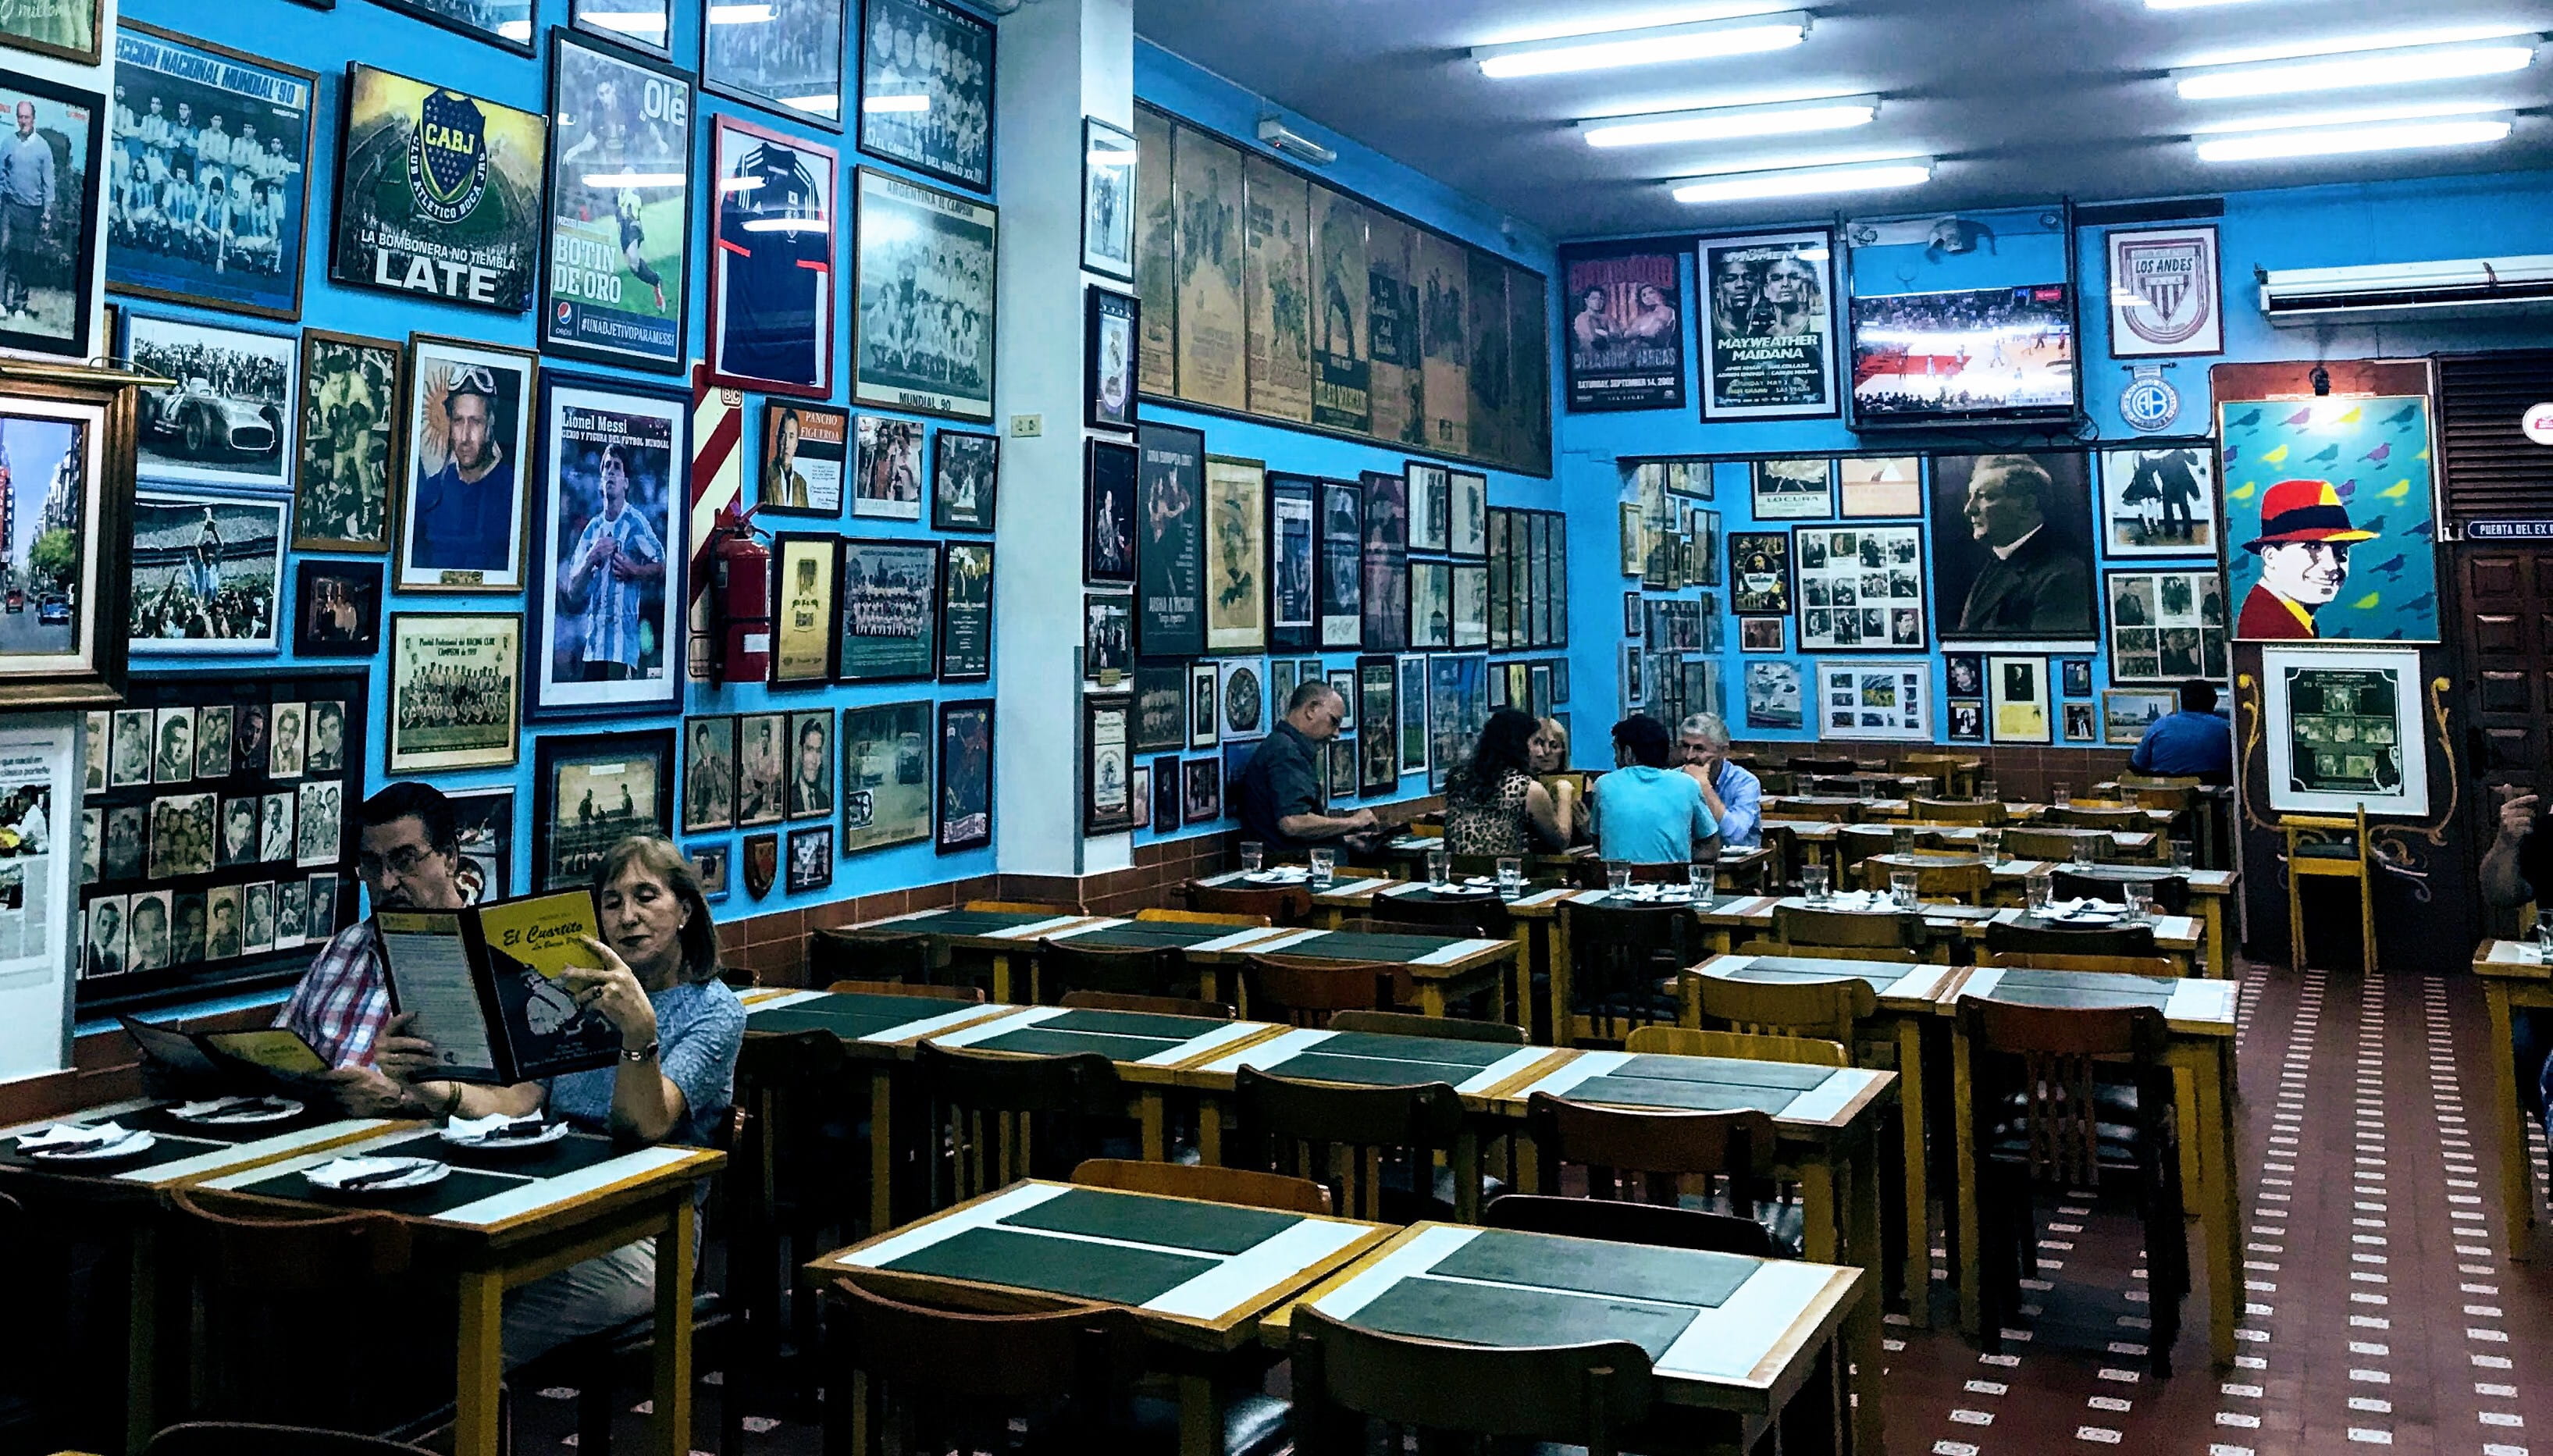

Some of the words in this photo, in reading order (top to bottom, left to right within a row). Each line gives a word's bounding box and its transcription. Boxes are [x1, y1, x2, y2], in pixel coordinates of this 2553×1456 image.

[159, 51, 219, 84] NACIONAL
[425, 123, 475, 155] CABJ
[410, 135, 420, 175] CLUB
[459, 185, 482, 215] BOCA
[926, 154, 940, 169] DEL
[942, 160, 963, 177] SIGLO
[887, 181, 936, 207] ARGENTINA
[361, 230, 375, 244] LA
[379, 233, 447, 259] BOMBONERA
[451, 247, 468, 262] NO
[471, 251, 516, 271] TIEMBLA
[555, 233, 616, 273] BOTIN
[375, 247, 497, 303] LATE
[2135, 260, 2153, 273] LOS
[2156, 258, 2192, 272] ANDES
[554, 264, 581, 295] DE
[583, 271, 621, 304] ORO
[1718, 335, 1818, 349] MAYWEATHER
[1732, 348, 1804, 361] MAIDANA
[899, 392, 936, 409] MUNDIAL
[941, 399, 951, 411] 90
[562, 411, 594, 430] Lionel
[598, 415, 628, 434] Messi
[806, 411, 838, 425] PANCHO
[581, 431, 584, 440] Y
[800, 426, 839, 441] FIGUEROA
[2480, 524, 2512, 535] PUERTA
[2516, 524, 2533, 535] DEL
[2534, 524, 2547, 535] EX
[503, 929, 519, 947] El
[526, 921, 583, 943] Cuartito
